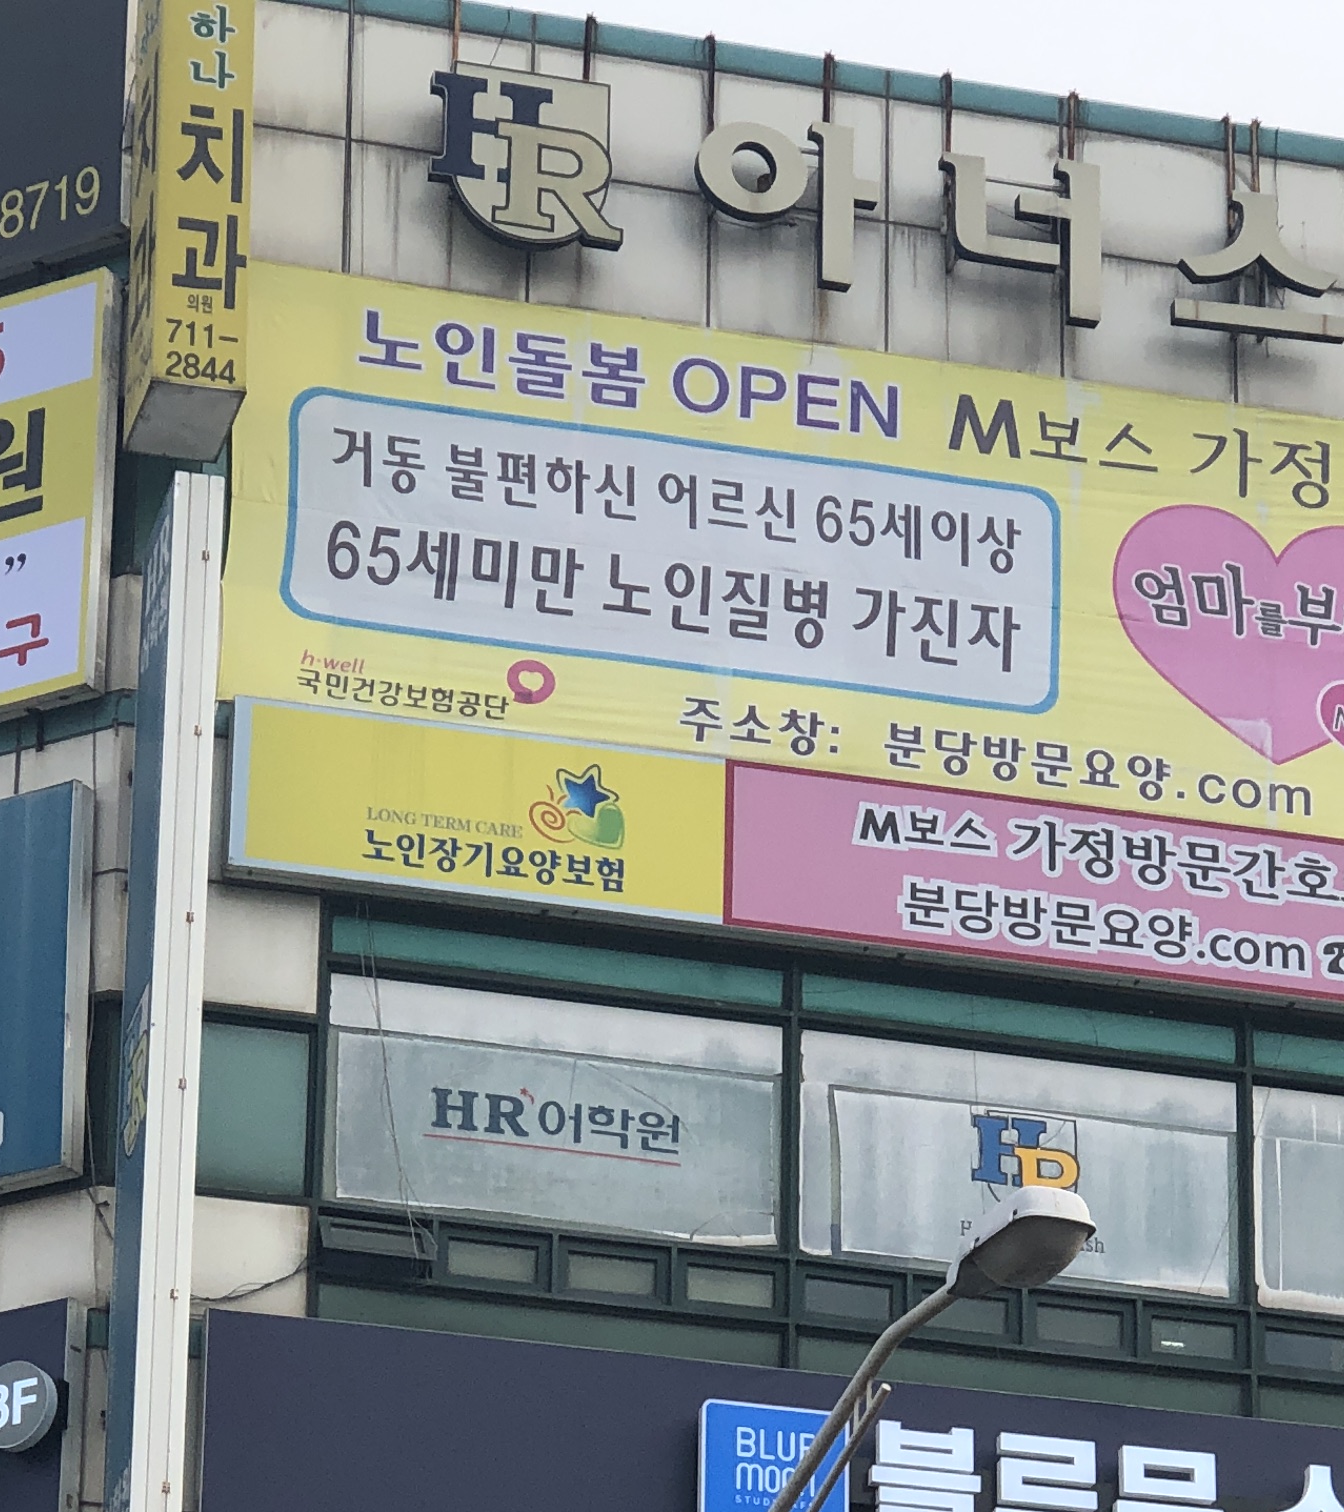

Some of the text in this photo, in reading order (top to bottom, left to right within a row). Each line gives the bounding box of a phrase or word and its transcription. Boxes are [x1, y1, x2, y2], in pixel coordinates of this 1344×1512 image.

[189, 4, 236, 90] 하나
[171, 104, 248, 310] 치과
[165, 317, 239, 349] 711-
[187, 293, 213, 315] 의원
[164, 350, 236, 385] 2844
[357, 308, 902, 439] 노인돌봄 OPEN
[948, 394, 1159, 475] M보스
[331, 425, 1023, 575] 거동 불편하신 어르신 65세이상
[326, 519, 1023, 673] 65세미만 노인질병 가진자
[296, 667, 511, 721] 국민건강보험공단
[678, 696, 1313, 819] 주소창: 분당방문요양.com
[361, 828, 627, 895] 노인장기요양보험
[366, 806, 524, 841] LONG TERM CARE
[859, 808, 993, 852] M보스
[900, 880, 1309, 975] 분당방문요양.com
